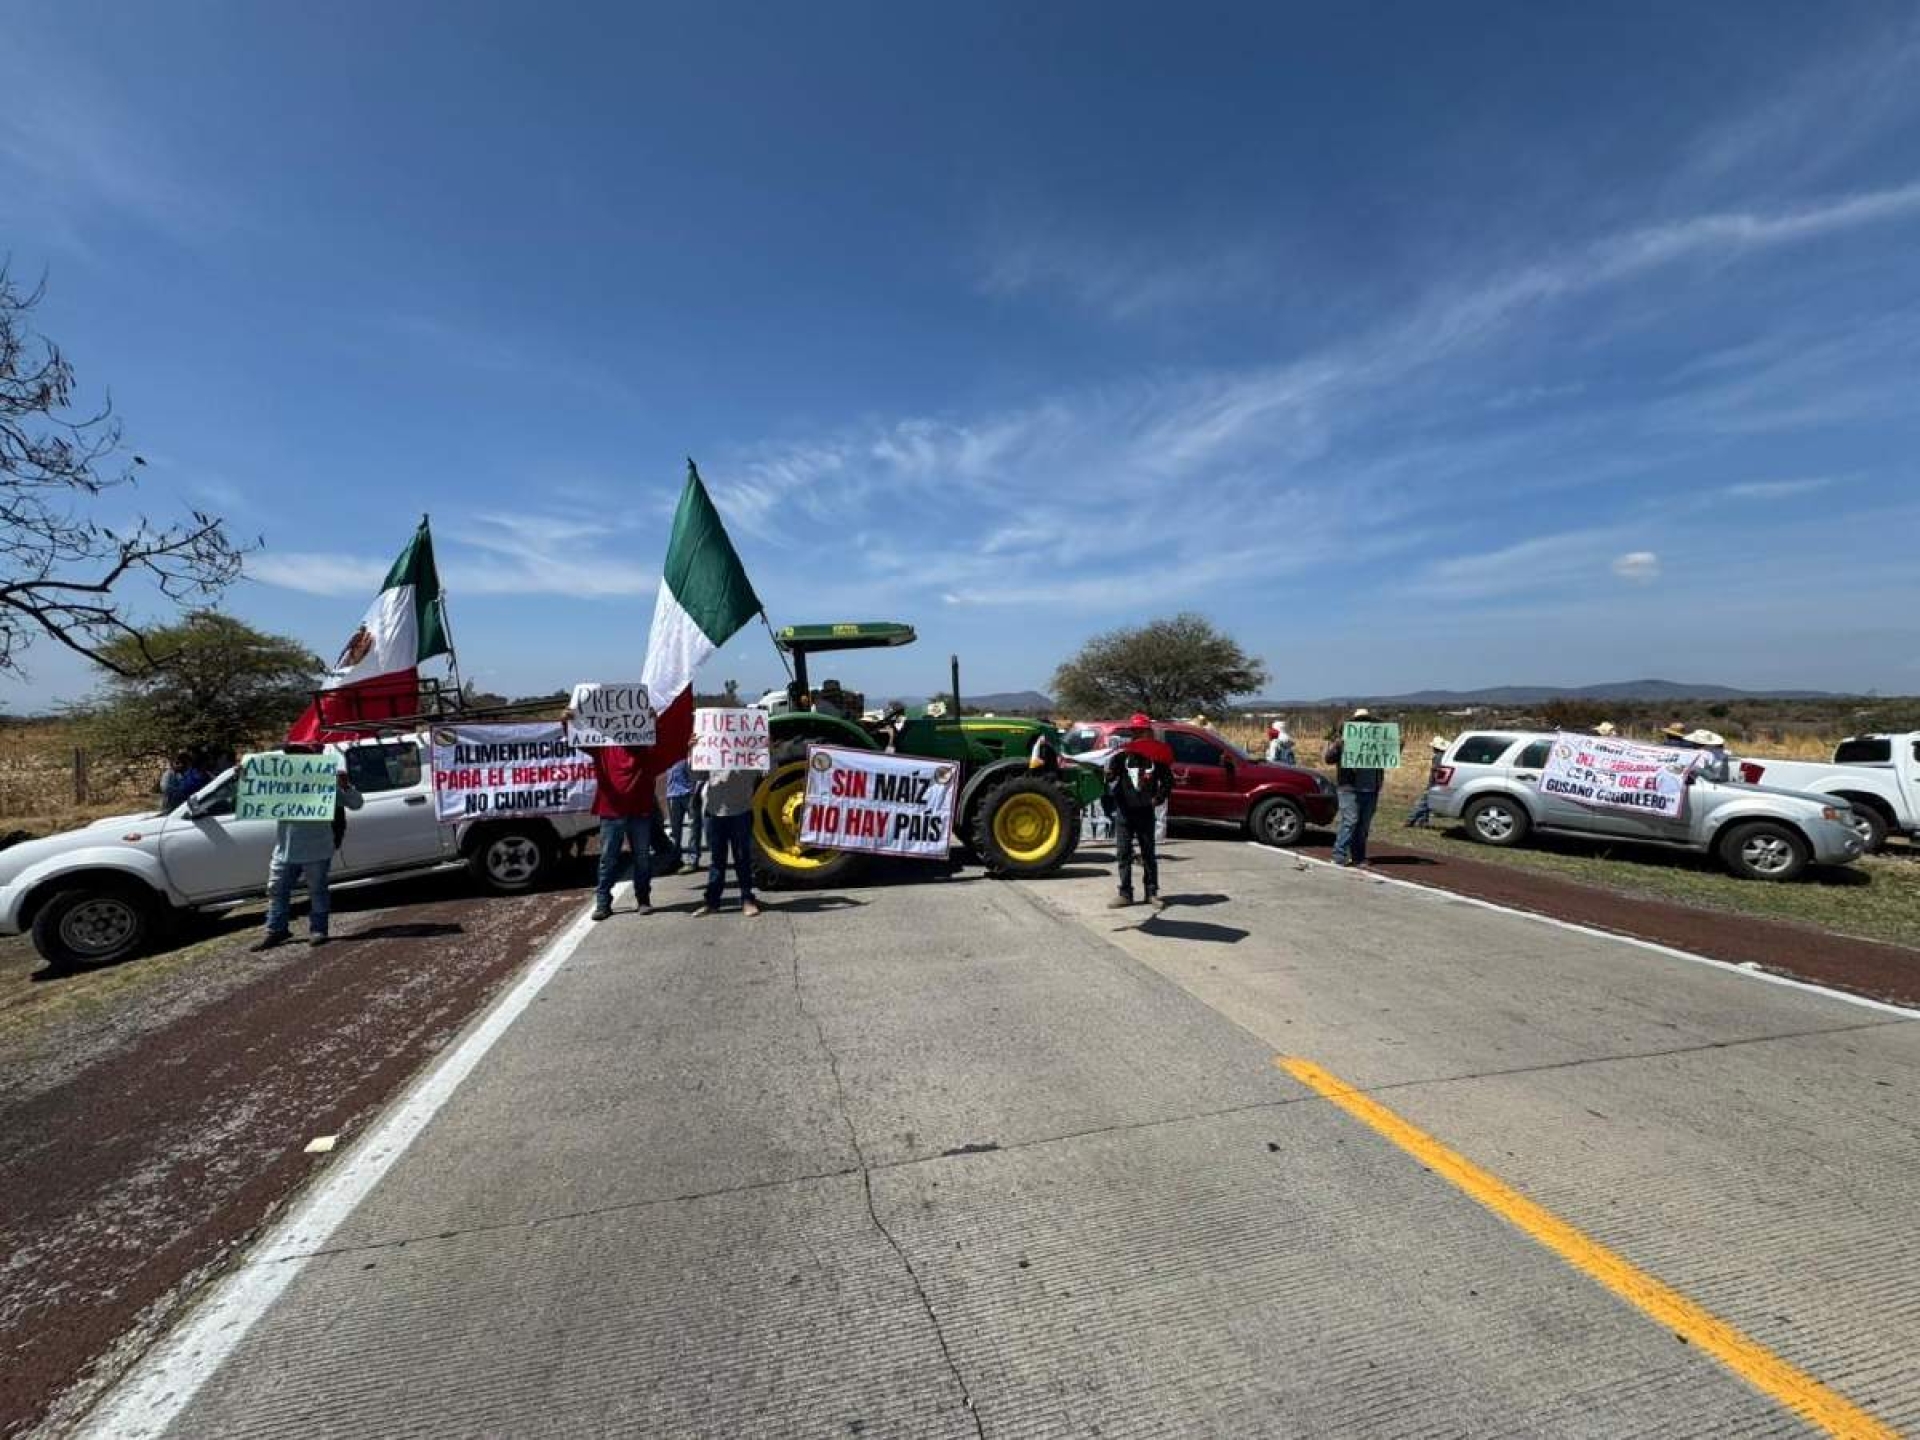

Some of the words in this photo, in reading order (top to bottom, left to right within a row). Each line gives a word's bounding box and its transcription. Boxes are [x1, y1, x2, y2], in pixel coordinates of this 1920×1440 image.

[577, 687, 649, 714] PRECIO
[701, 713, 767, 732] FUERA
[245, 758, 294, 777] ALTO
[302, 762, 312, 774] A
[436, 768, 482, 791] PARA
[488, 767, 506, 786] EL
[832, 769, 868, 798] SIN
[874, 770, 931, 804] MAÍZ
[1546, 778, 1593, 797] GUSANO
[1619, 776, 1640, 788] QUE
[243, 803, 265, 817] DE
[271, 803, 327, 817] GRANO
[465, 793, 488, 813] NO
[494, 787, 568, 811] CUMPLE!
[809, 804, 841, 833] NO
[845, 807, 889, 838] HAY
[894, 810, 942, 842] PAÍS
